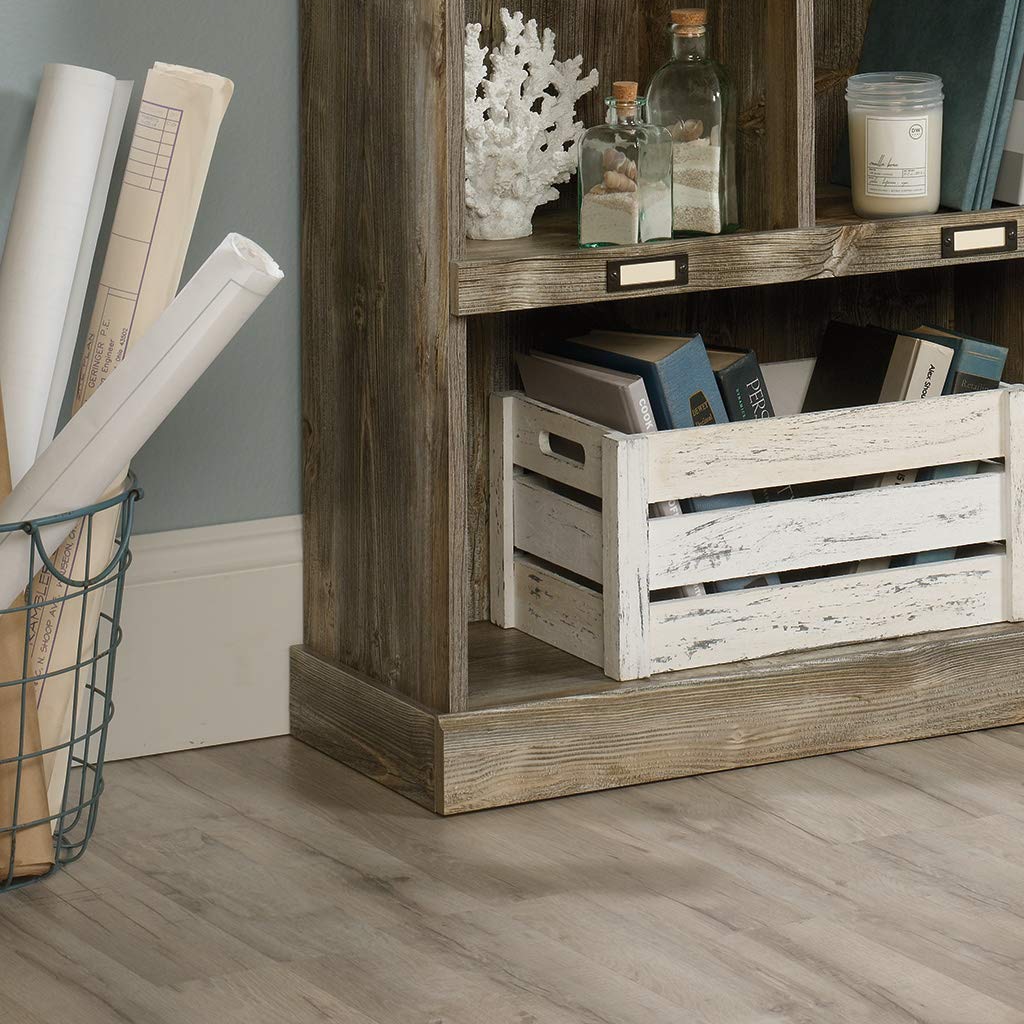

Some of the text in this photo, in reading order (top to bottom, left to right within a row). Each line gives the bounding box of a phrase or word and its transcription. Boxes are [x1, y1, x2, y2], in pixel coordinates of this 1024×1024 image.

[88, 342, 105, 389] GERINGER
[100, 319, 111, 337] P.E.
[101, 339, 116, 373] Engineer
[926, 363, 935, 381] Alex
[638, 398, 653, 430] COOK
[40, 620, 52, 653] SHOOP
